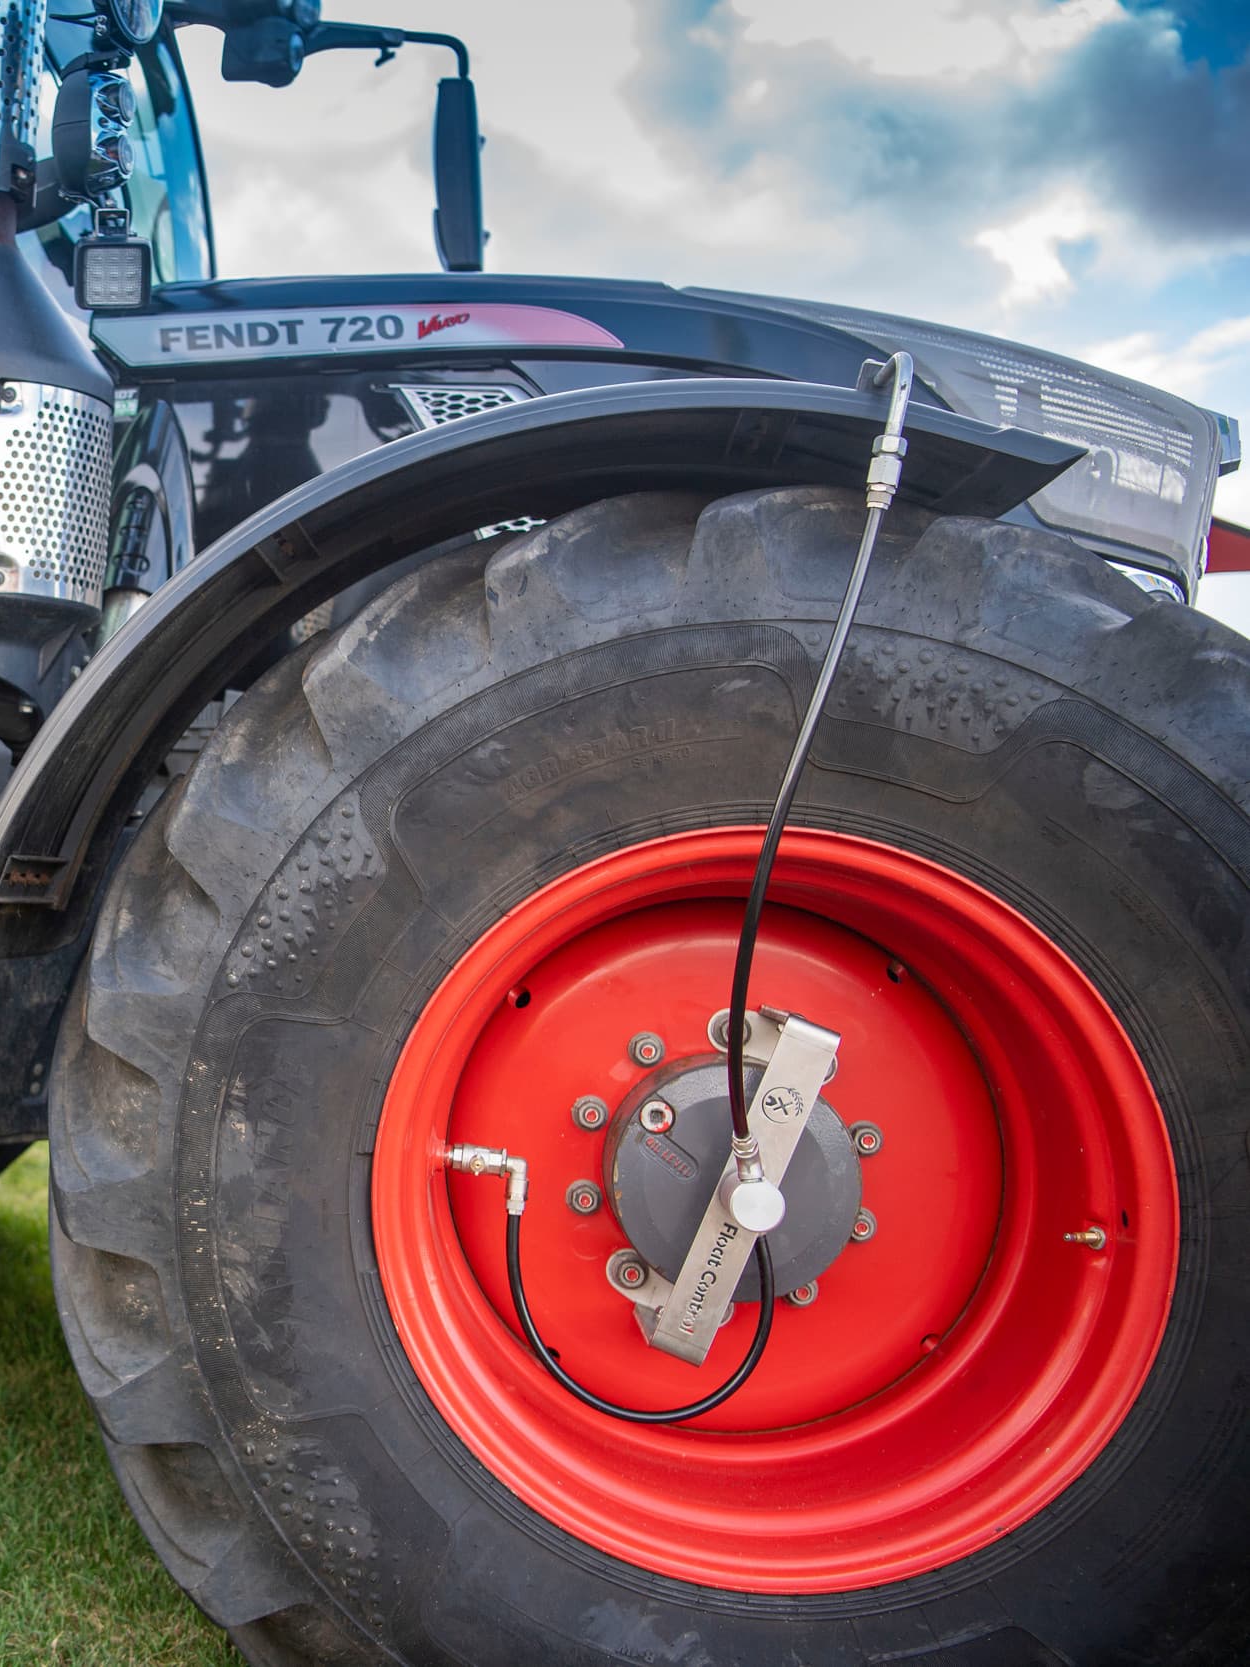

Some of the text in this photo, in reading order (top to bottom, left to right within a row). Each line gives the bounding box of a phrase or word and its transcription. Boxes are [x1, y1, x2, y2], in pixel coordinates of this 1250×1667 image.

[159, 319, 304, 353] FENDT
[320, 314, 404, 343] 720
[679, 1222, 739, 1336] Float Control
